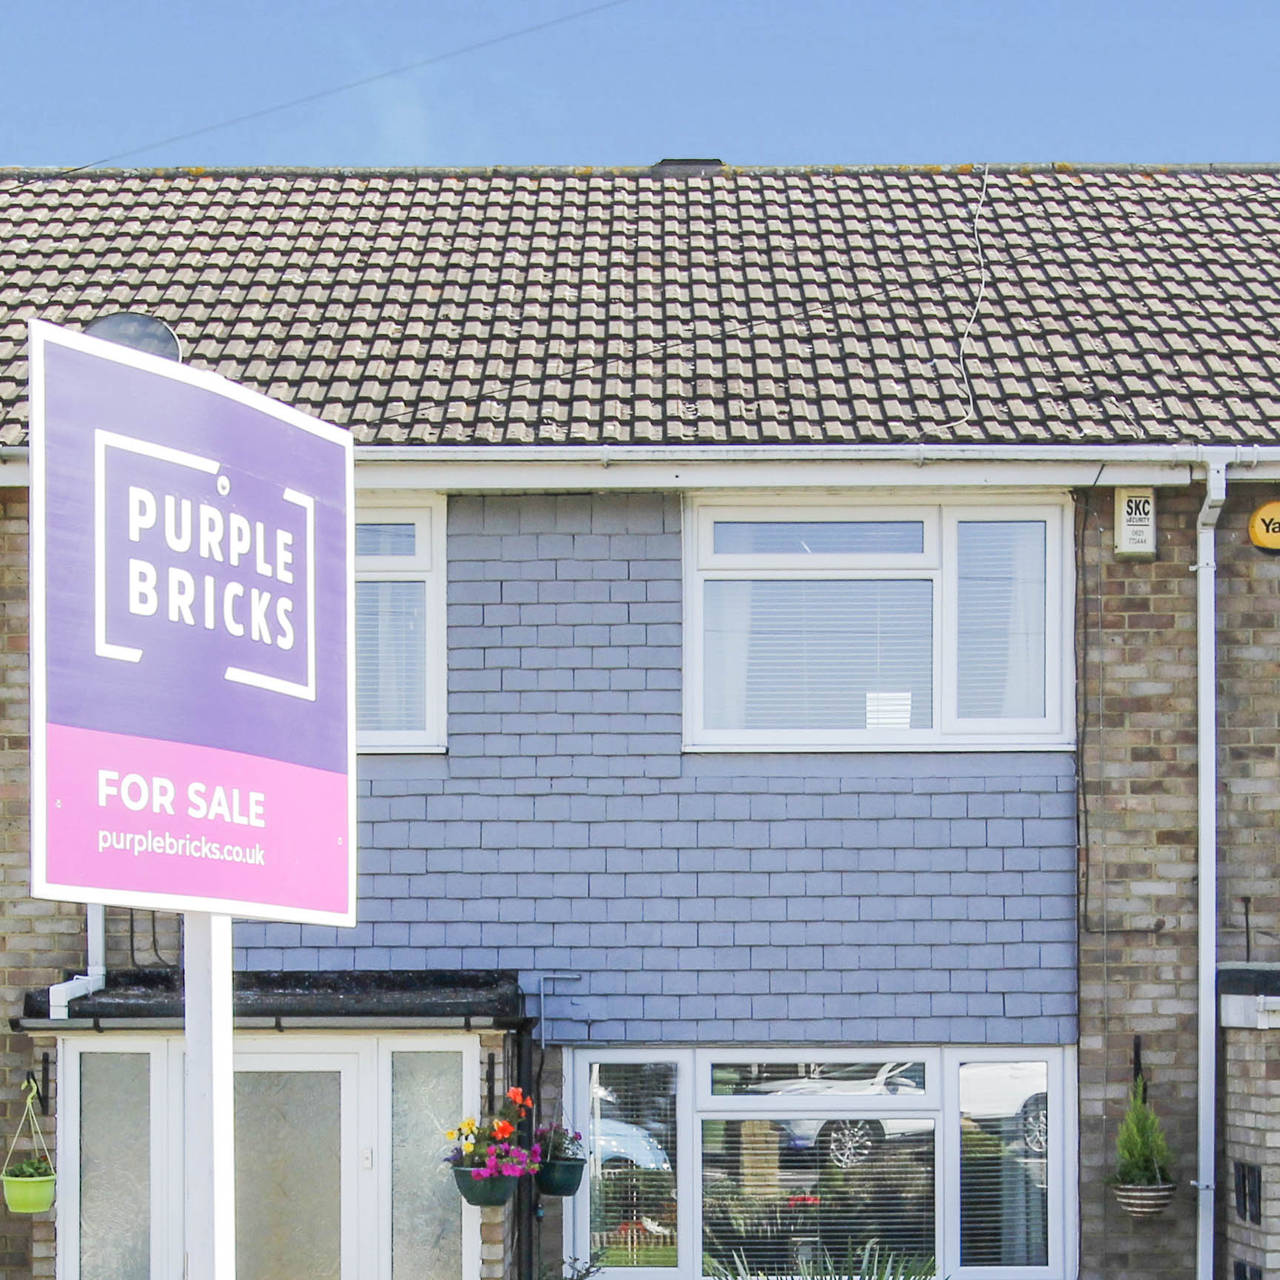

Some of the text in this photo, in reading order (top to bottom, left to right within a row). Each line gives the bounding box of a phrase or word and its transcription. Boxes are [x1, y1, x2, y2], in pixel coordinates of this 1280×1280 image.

[128, 485, 294, 585] PURPLE
[1126, 498, 1150, 516] SKC
[128, 557, 295, 651] BRICKS
[97, 768, 267, 828] FOR SALE
[97, 829, 266, 867] purplebricks.co.uk
